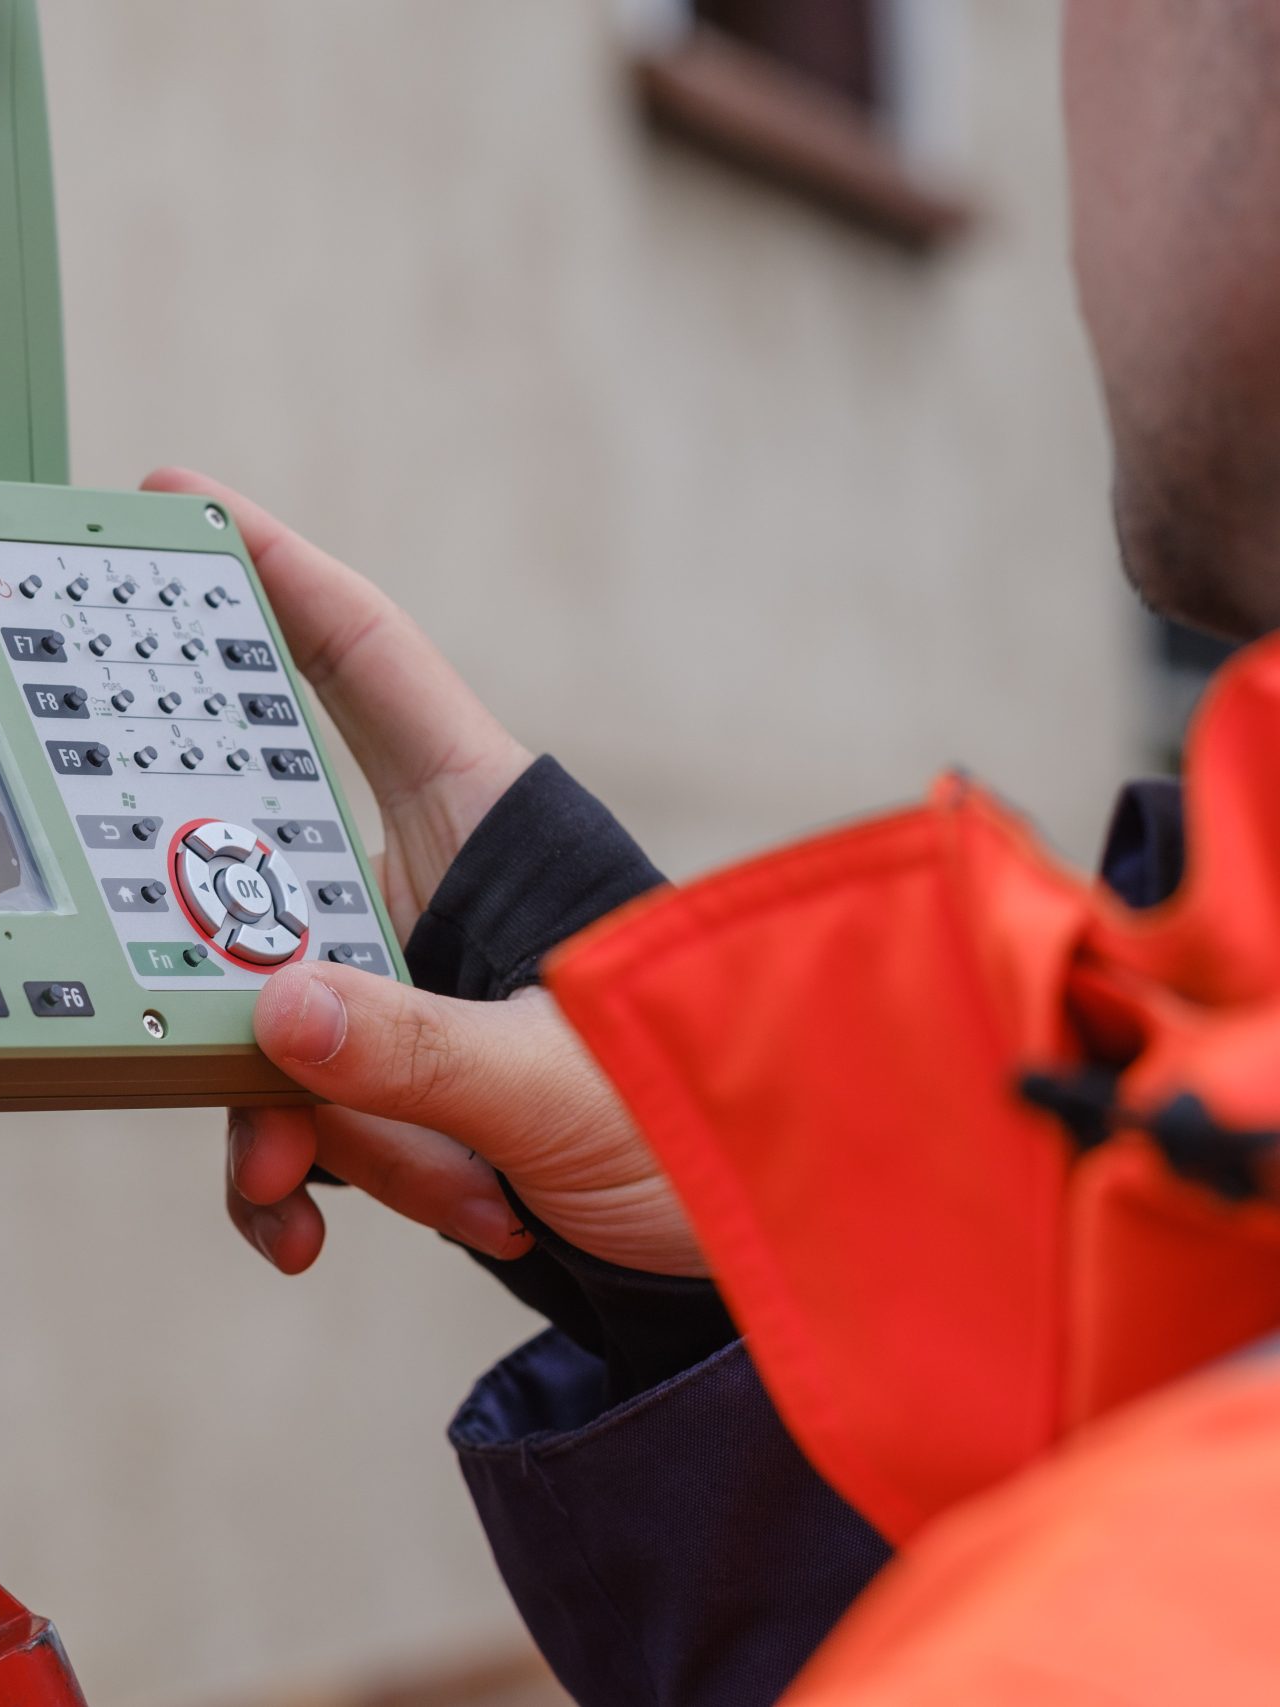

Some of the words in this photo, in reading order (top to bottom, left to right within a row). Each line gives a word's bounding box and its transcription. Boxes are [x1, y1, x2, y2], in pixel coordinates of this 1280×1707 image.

[57, 556, 66, 570] 1
[103, 559, 114, 573] 2
[149, 561, 160, 576] 3
[79, 611, 88, 625] 4
[125, 613, 136, 628] 5
[171, 616, 182, 630] 6
[13, 635, 35, 655] F7
[102, 666, 111, 681] 7
[148, 668, 158, 683] 8
[194, 670, 204, 685] 9
[35, 691, 60, 711] F8
[171, 724, 181, 738] 0
[57, 748, 82, 768] F9
[236, 879, 264, 900] OK
[147, 949, 174, 969] Fn
[61, 987, 85, 1008] F6
